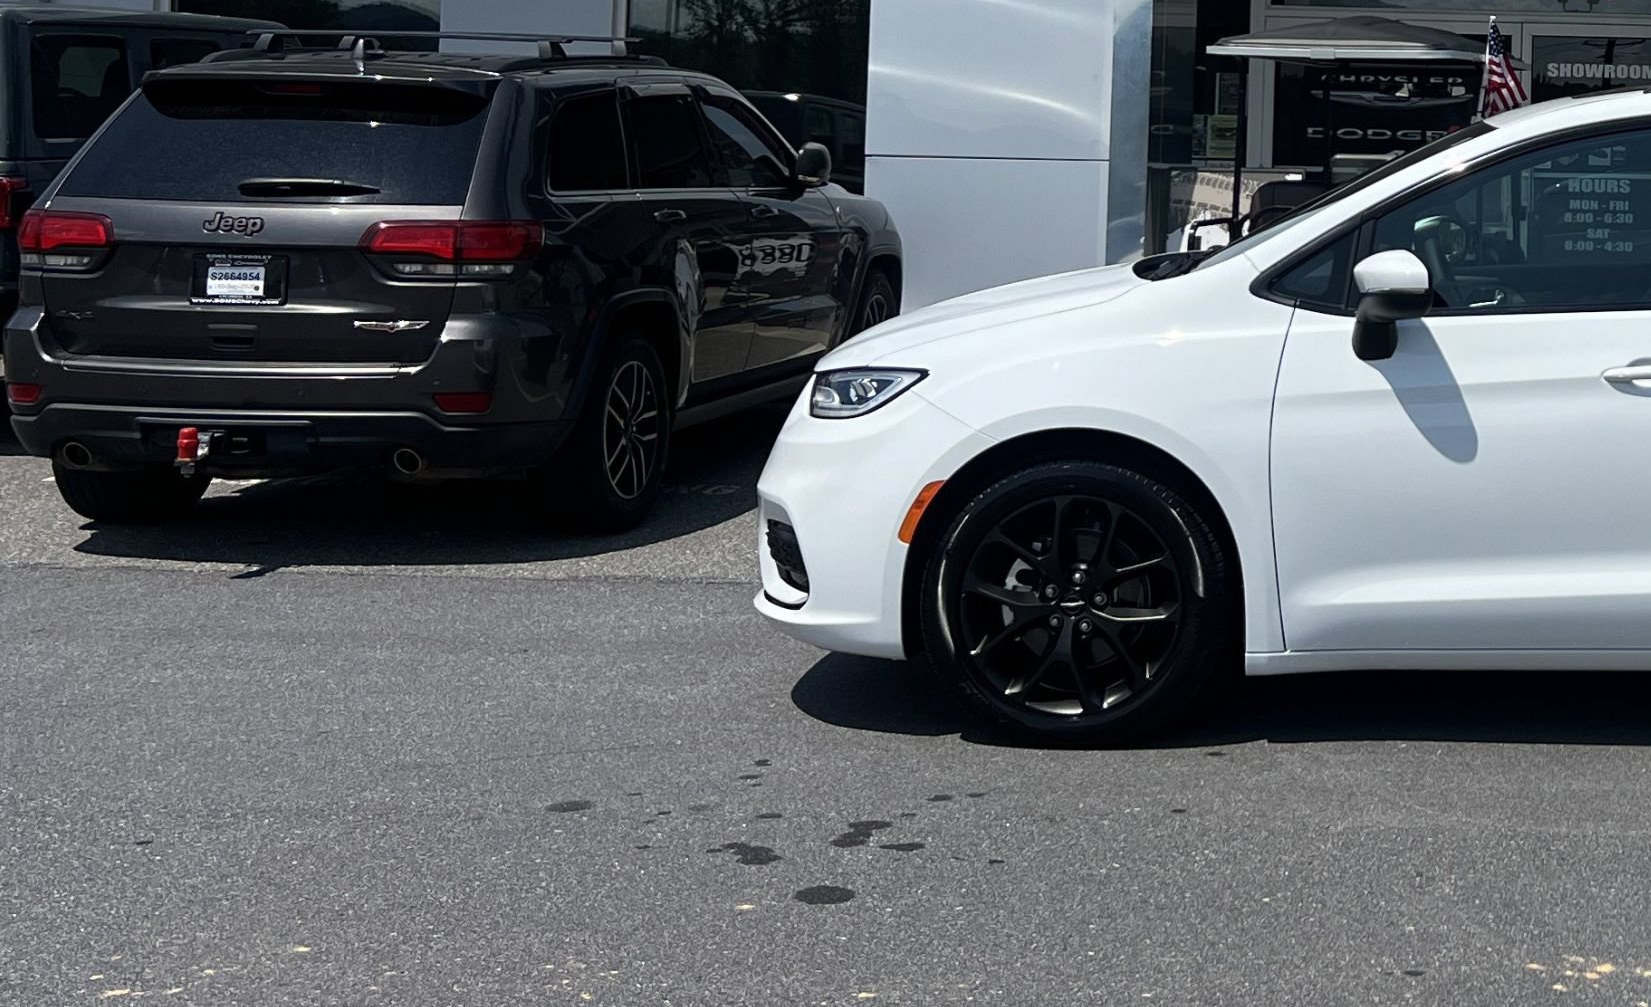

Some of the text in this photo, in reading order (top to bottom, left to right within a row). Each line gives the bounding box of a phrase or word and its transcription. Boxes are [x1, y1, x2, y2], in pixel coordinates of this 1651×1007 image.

[1567, 178, 1631, 194] HOURS
[1569, 199, 1599, 210] MON
[1609, 200, 1629, 211] FRI
[203, 212, 265, 236] Jeep
[1563, 212, 1594, 223] 8:00
[1604, 213, 1634, 224] 6:30
[1586, 228, 1610, 239] SAT
[1604, 241, 1634, 252] 4:30
